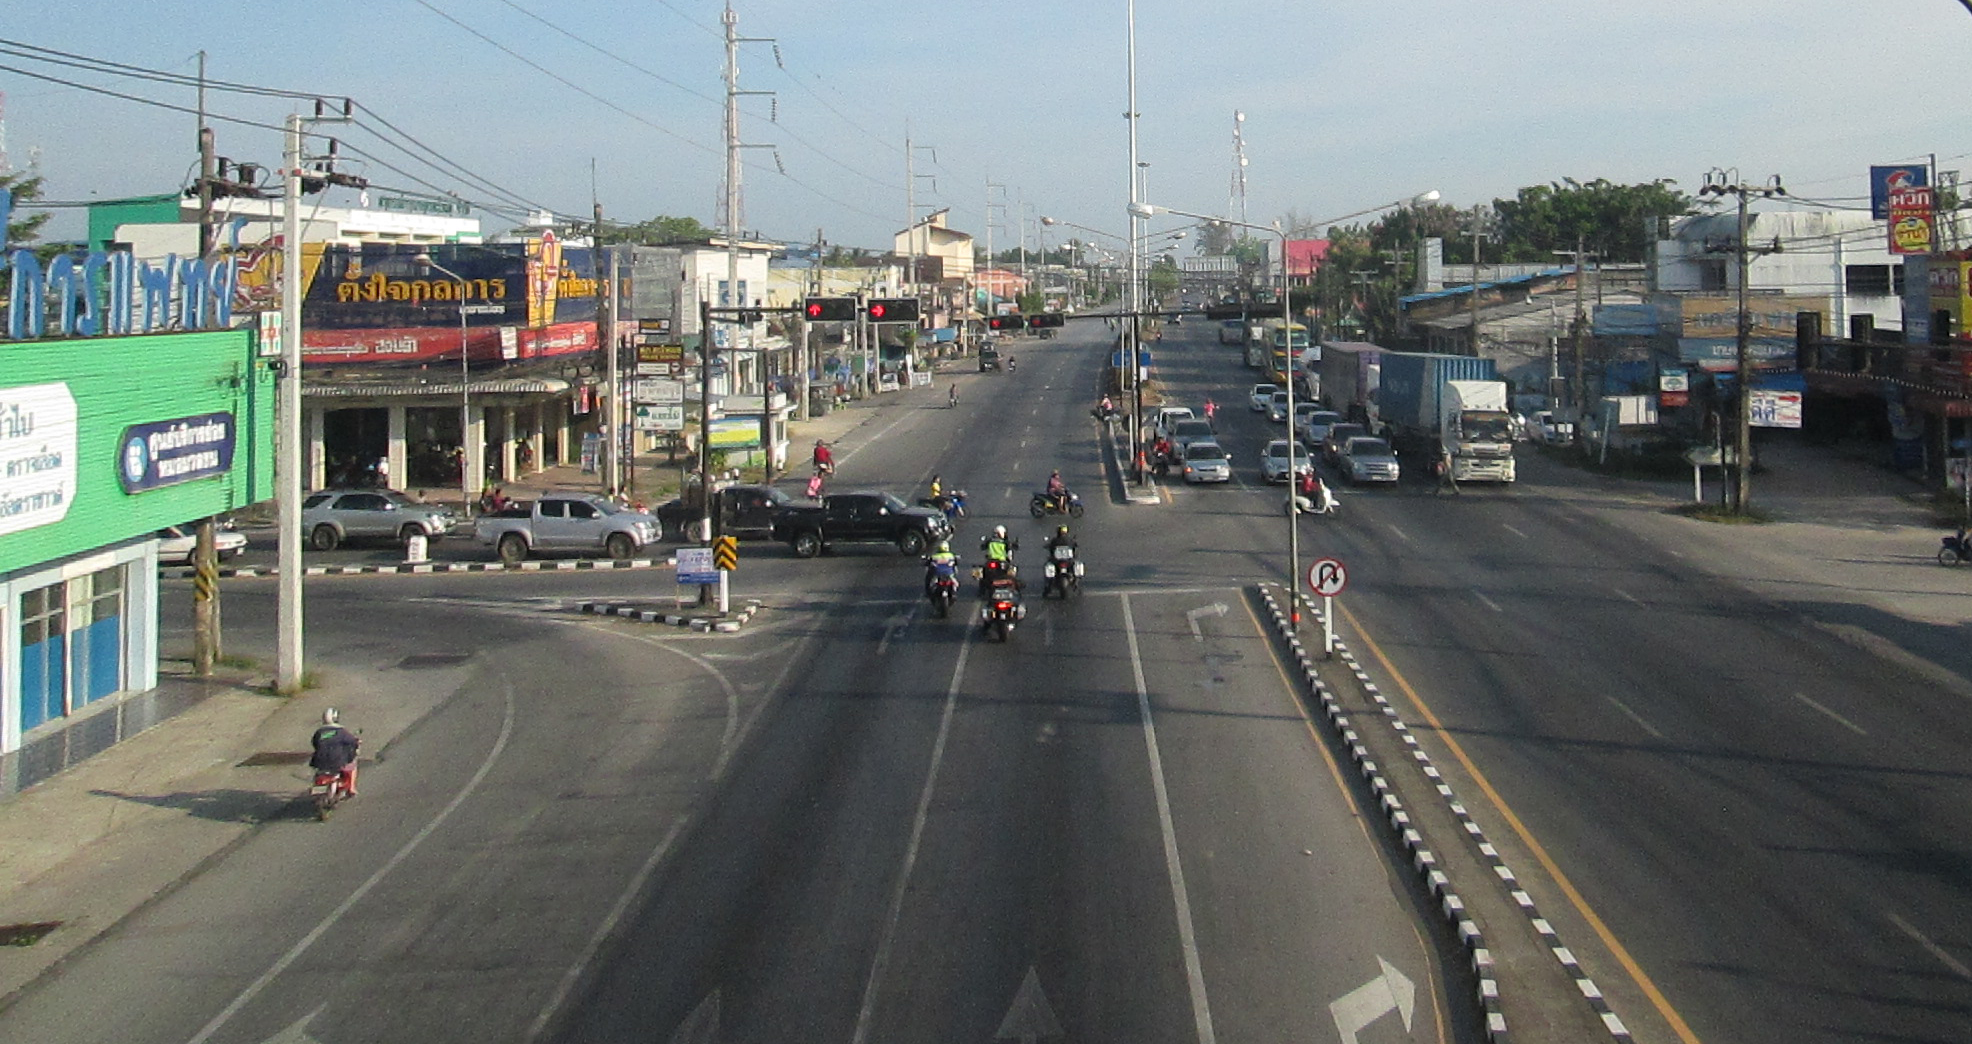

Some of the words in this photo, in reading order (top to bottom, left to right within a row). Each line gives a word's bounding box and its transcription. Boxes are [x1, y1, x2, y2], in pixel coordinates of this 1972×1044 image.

[338, 263, 507, 302] ตั้งใจกลการ
